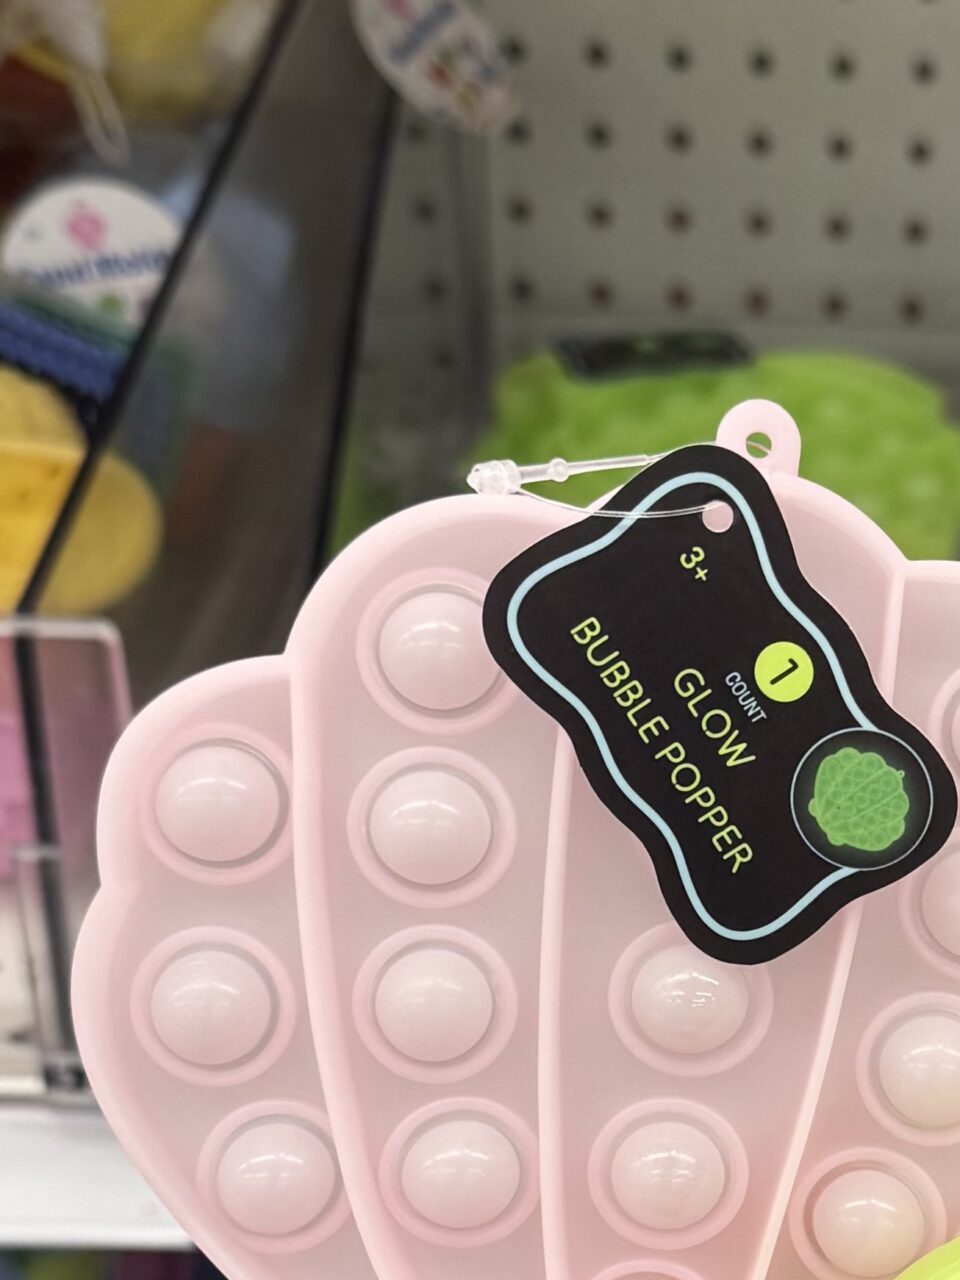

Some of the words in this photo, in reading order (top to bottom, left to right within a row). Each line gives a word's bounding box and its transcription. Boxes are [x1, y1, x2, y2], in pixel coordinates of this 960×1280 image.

[679, 546, 709, 582] 3+
[725, 671, 767, 723] COUNT
[769, 657, 799, 686] 1
[674, 668, 757, 767] GLOW
[569, 616, 670, 744] BUBBLE
[654, 741, 753, 874] POPPER
